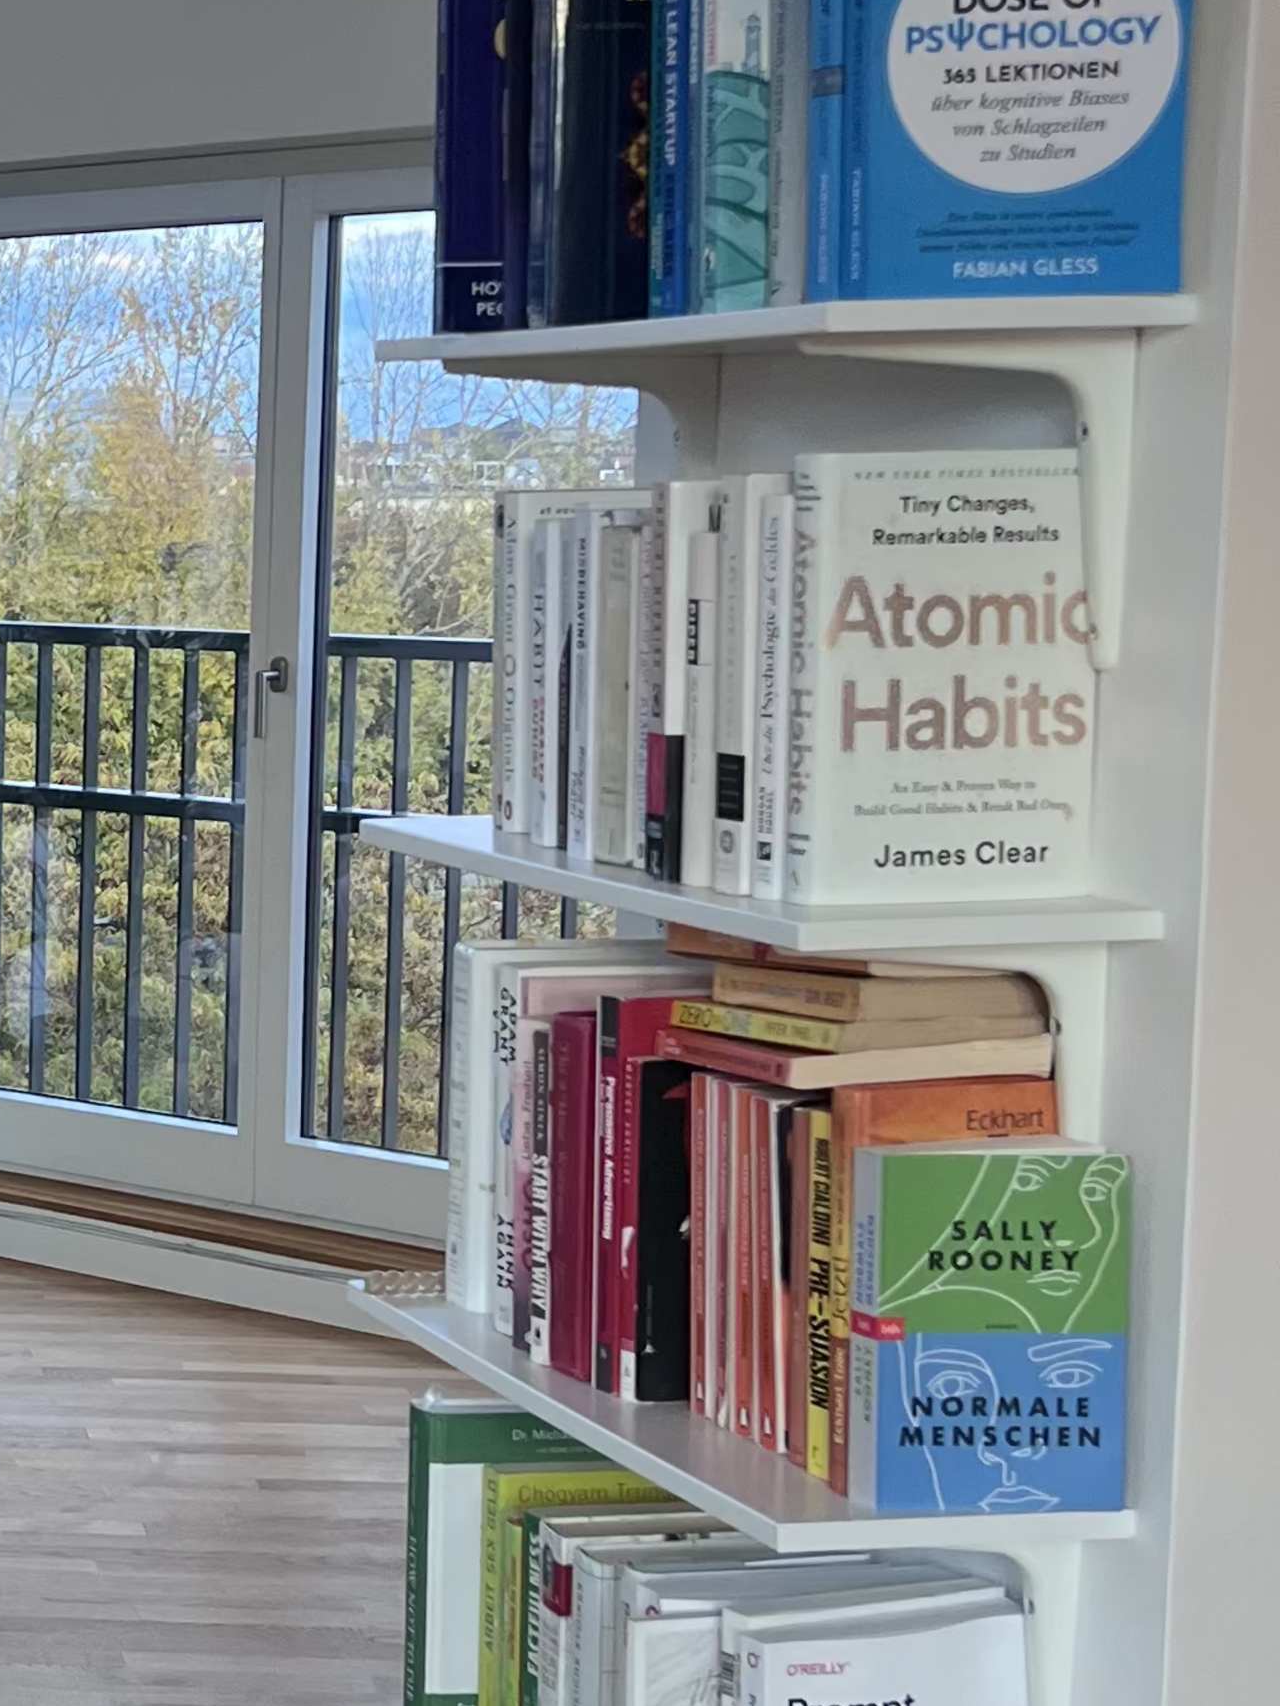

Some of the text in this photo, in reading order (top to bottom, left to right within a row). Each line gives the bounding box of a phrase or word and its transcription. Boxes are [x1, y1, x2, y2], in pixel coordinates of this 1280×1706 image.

[665, 10, 679, 65] LEAN
[942, 60, 1121, 85] 365 LEKTIONEN
[664, 71, 678, 165] STARTUP
[931, 89, 1130, 114] über kognitive Biases
[953, 118, 1106, 140] von Schlagzeilen
[980, 142, 1077, 162] zu Studien
[953, 256, 1100, 280] FABIAN GLESS
[899, 494, 1036, 517] Tiny Changes,
[504, 517, 516, 574] Adam
[872, 523, 1060, 546] Remarkable Results
[504, 583, 517, 643] Grant
[576, 537, 586, 649] MISBEHAVING
[824, 571, 1094, 649] Atomic
[532, 594, 545, 689] HABIT
[760, 611, 780, 720] Psychologie
[788, 529, 818, 815] Atomic Habits
[842, 674, 1087, 752] Habits
[941, 781, 954, 793] &
[966, 801, 979, 814] &
[874, 839, 1050, 868] James Clear
[500, 987, 509, 1067] GRANT
[509, 994, 517, 1062] ADAM
[965, 1108, 1045, 1132] Eckhart
[532, 1153, 549, 1211] START
[602, 1076, 616, 1241] Persuasive Advertising
[532, 1215, 548, 1264] WITH
[812, 1180, 831, 1247] CIALDINI
[951, 1220, 1057, 1242] SALLY
[496, 1213, 506, 1289] AGAIN
[505, 1220, 515, 1292] THINK
[927, 1250, 1080, 1272] ROONEY
[531, 1266, 548, 1308] WHY
[809, 1256, 831, 1410] PRE-SUASION
[910, 1396, 1091, 1418] NORMALE
[512, 1429, 527, 1441] Dr.
[898, 1425, 1102, 1448] MENSCHEN
[484, 1478, 497, 1653] ARBEIT SEX GELD
[786, 1661, 846, 1676] O'REILLY
